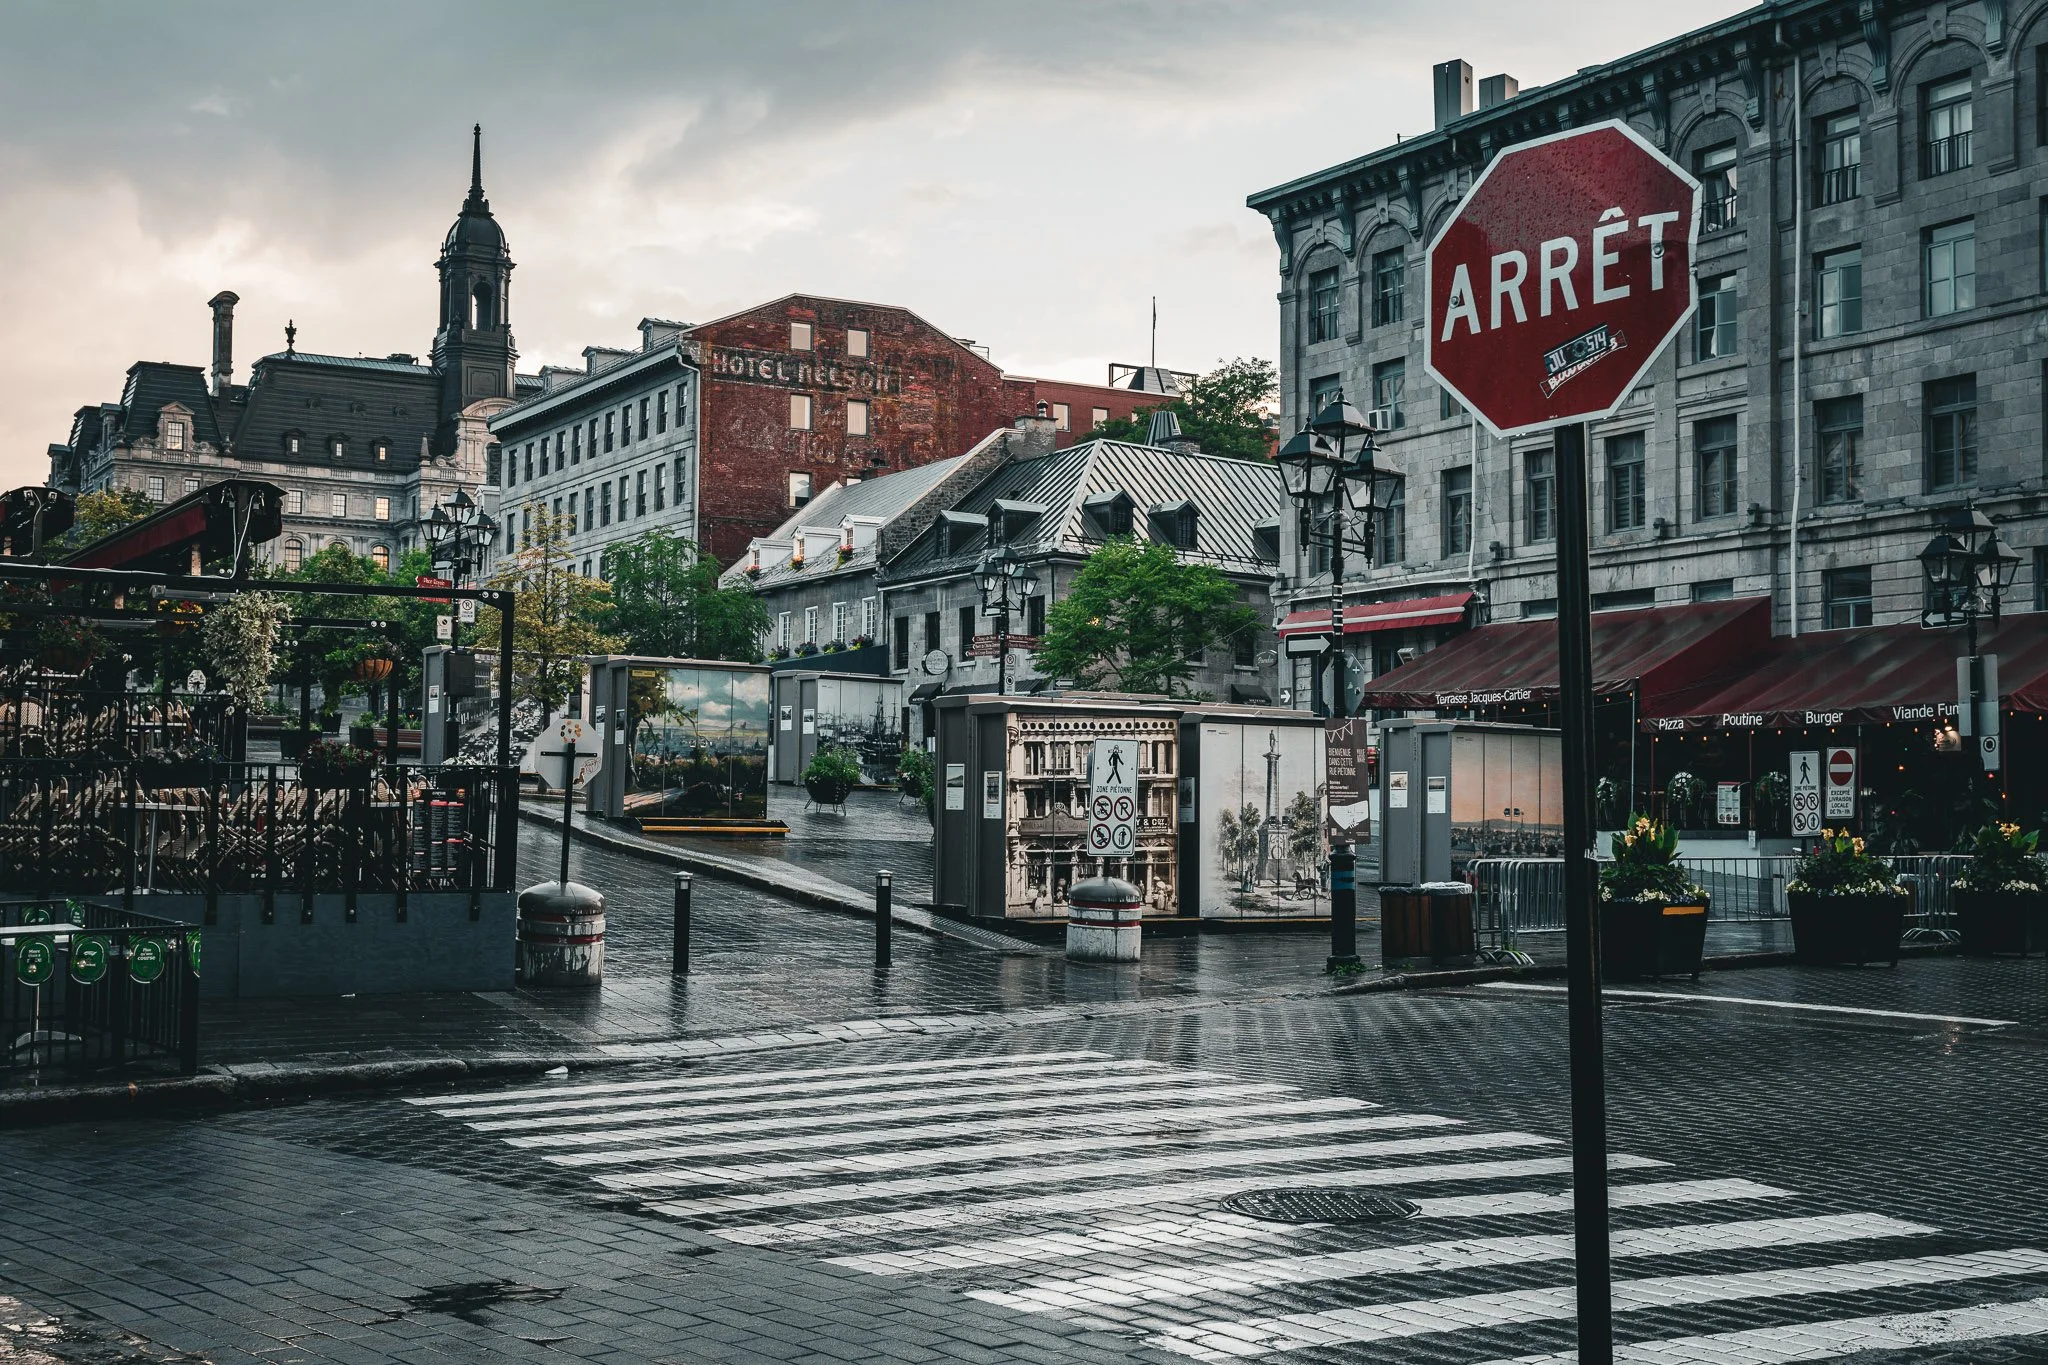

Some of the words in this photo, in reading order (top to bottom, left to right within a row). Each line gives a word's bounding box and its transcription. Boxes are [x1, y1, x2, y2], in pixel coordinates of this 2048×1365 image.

[1440, 205, 1680, 343] ARRÊT
[1585, 331, 1607, 353] 514
[712, 352, 790, 382] HOTEL
[1435, 693, 1468, 705] Terrasse
[1469, 688, 1532, 705] Jacques-Cartier
[1722, 712, 1763, 726] Poutine
[1805, 710, 1844, 726] Burger
[1892, 704, 1935, 720] Viande
[1658, 718, 1684, 731] Pizza
[1096, 785, 1109, 793] ZONE
[1109, 784, 1133, 794] PIÉTONNE
[1143, 818, 1150, 826] &
